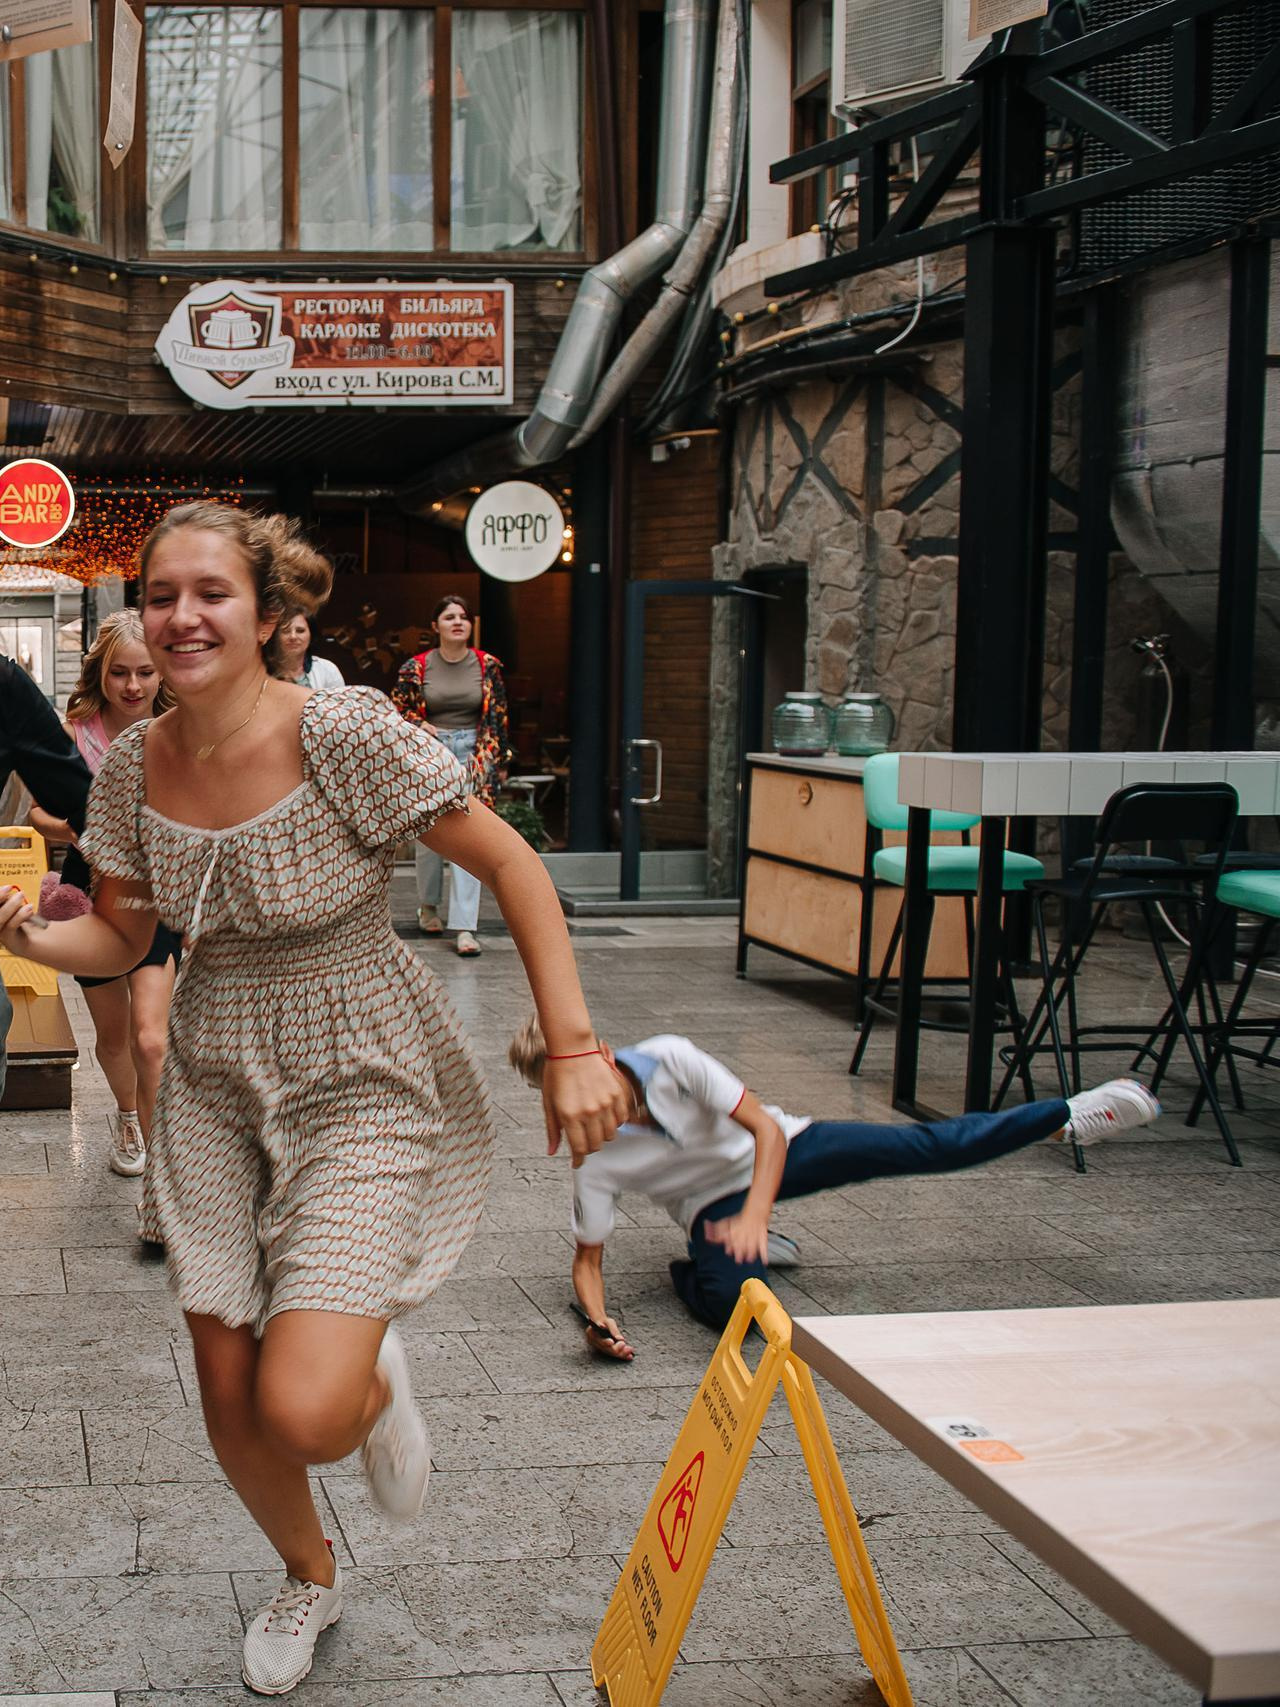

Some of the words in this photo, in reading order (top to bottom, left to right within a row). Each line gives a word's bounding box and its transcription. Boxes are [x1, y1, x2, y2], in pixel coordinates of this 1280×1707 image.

[294, 298, 384, 315] РЕСТОРАН
[399, 298, 485, 316] БИЛЬЯРД
[300, 322, 381, 339] КАРАОКЕ
[390, 321, 497, 340] ДИСКОТЕКА
[275, 376, 323, 391] вход
[327, 376, 337, 388] с
[342, 376, 370, 392] ул.
[376, 371, 453, 391] Кирова
[459, 370, 500, 388] С.М.
[0, 484, 62, 503] ANDY
[0, 504, 48, 524] BAR
[711, 1376, 738, 1432] ОСТОРОЖНО
[641, 1554, 663, 1617] CAUTION
[632, 1565, 644, 1599] WET
[640, 1595, 657, 1648] FLOOR
